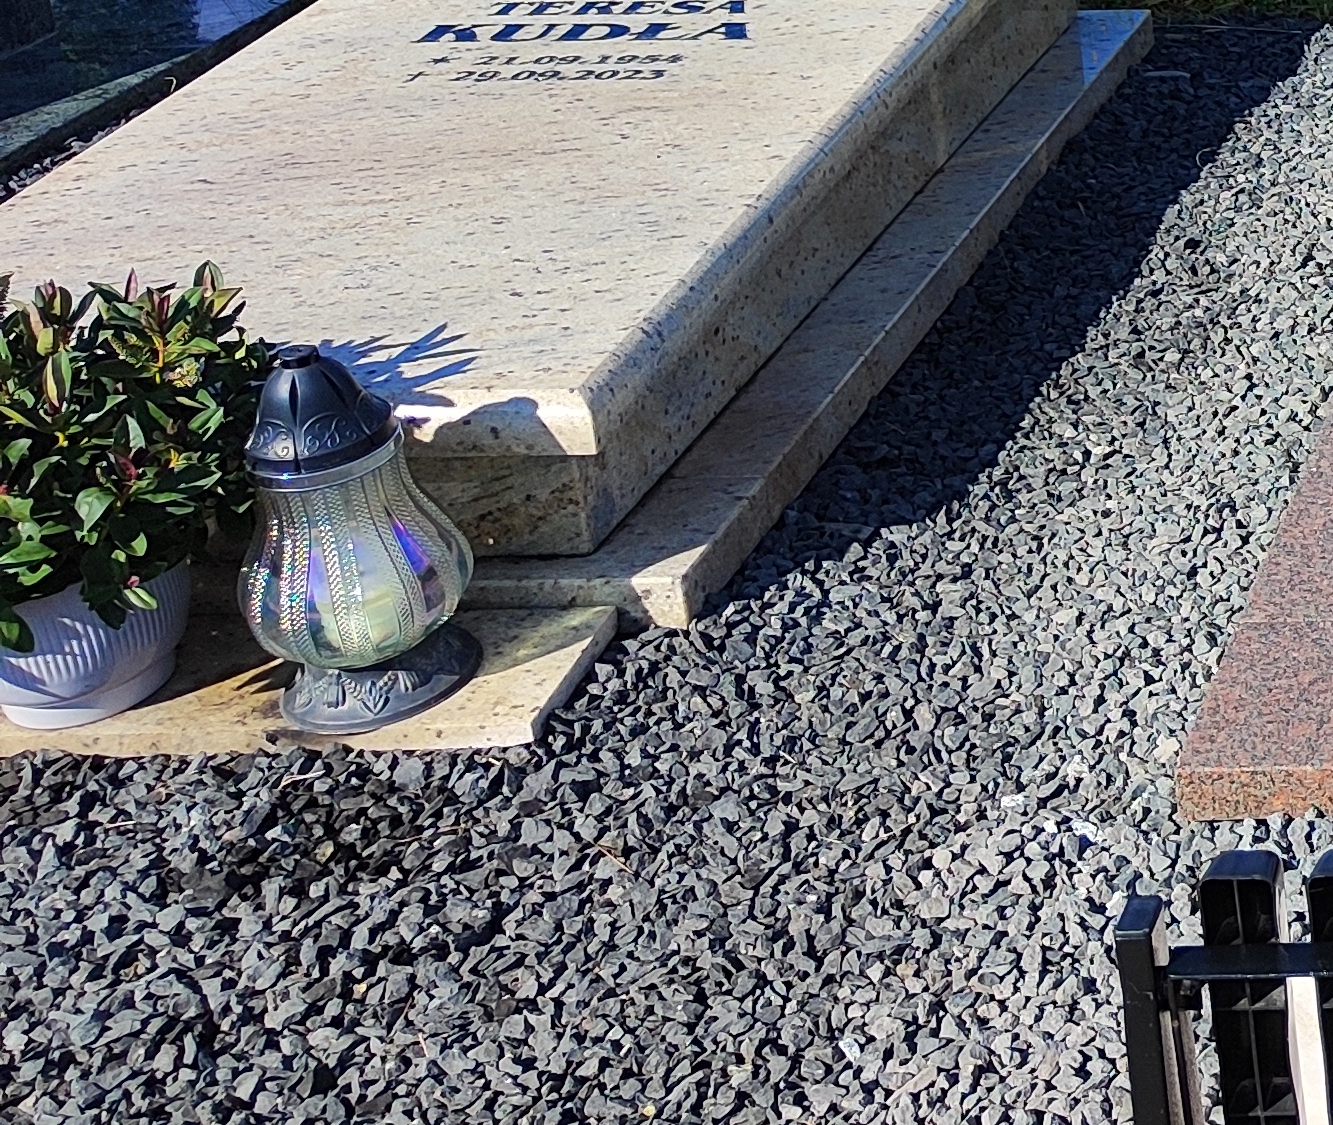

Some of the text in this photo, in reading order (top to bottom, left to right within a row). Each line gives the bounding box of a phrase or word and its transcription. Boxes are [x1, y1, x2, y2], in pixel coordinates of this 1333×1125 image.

[488, 0, 747, 16] TERESA
[410, 22, 752, 43] KUDŁA
[450, 70, 668, 82] 29.09.2023
